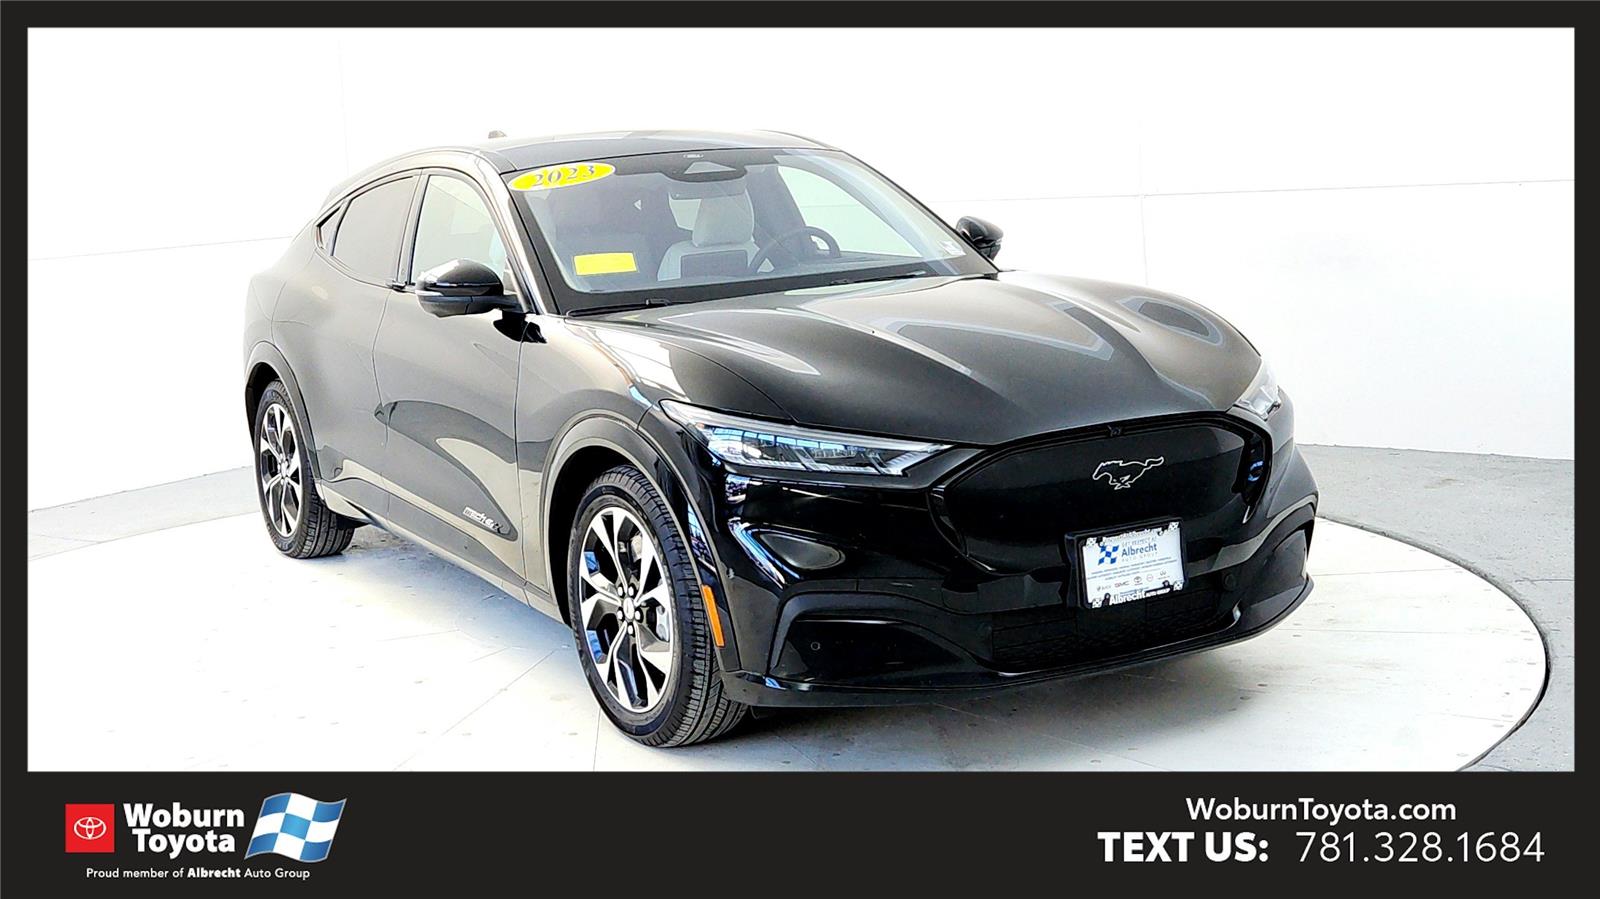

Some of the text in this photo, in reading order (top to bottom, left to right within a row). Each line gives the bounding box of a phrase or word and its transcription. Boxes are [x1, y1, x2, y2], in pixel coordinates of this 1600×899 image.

[532, 165, 595, 187] 2023
[1121, 543, 1157, 557] Albrecht
[1109, 590, 1146, 606] Albrecht
